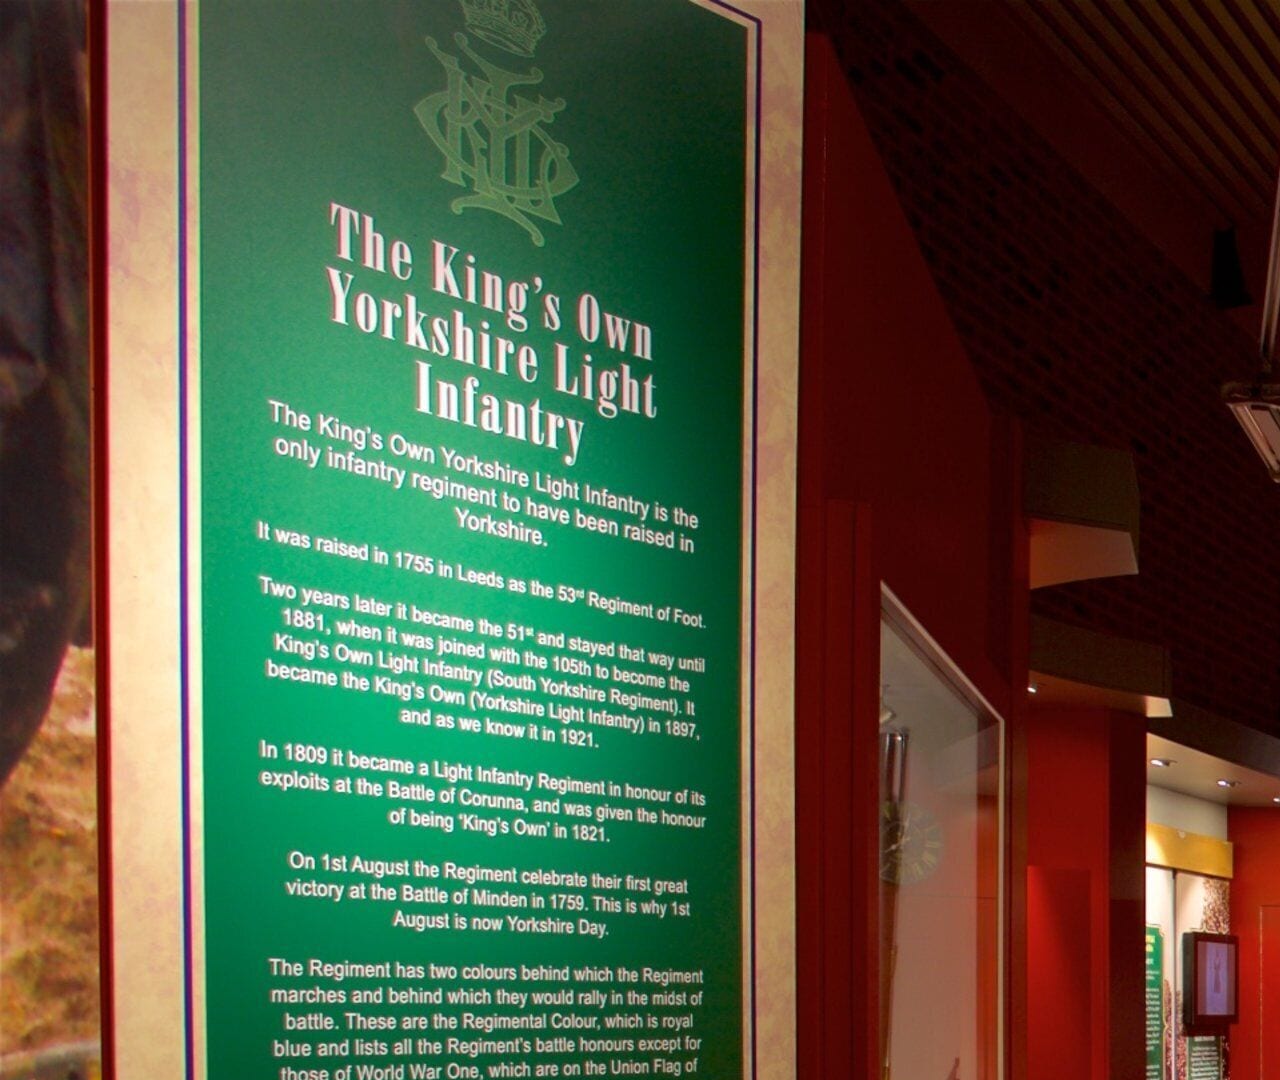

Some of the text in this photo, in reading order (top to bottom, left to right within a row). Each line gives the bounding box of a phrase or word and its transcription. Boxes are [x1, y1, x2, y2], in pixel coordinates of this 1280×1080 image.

[326, 266, 658, 418] Yorkshire Light
[329, 202, 651, 361] The King's Own
[267, 398, 699, 530] The King's Own Yorkshire Light Infantry is the
[415, 359, 583, 467] Infantry
[273, 437, 695, 554] only infantry regiment to have been raised in
[453, 506, 548, 548] Yorkshire.
